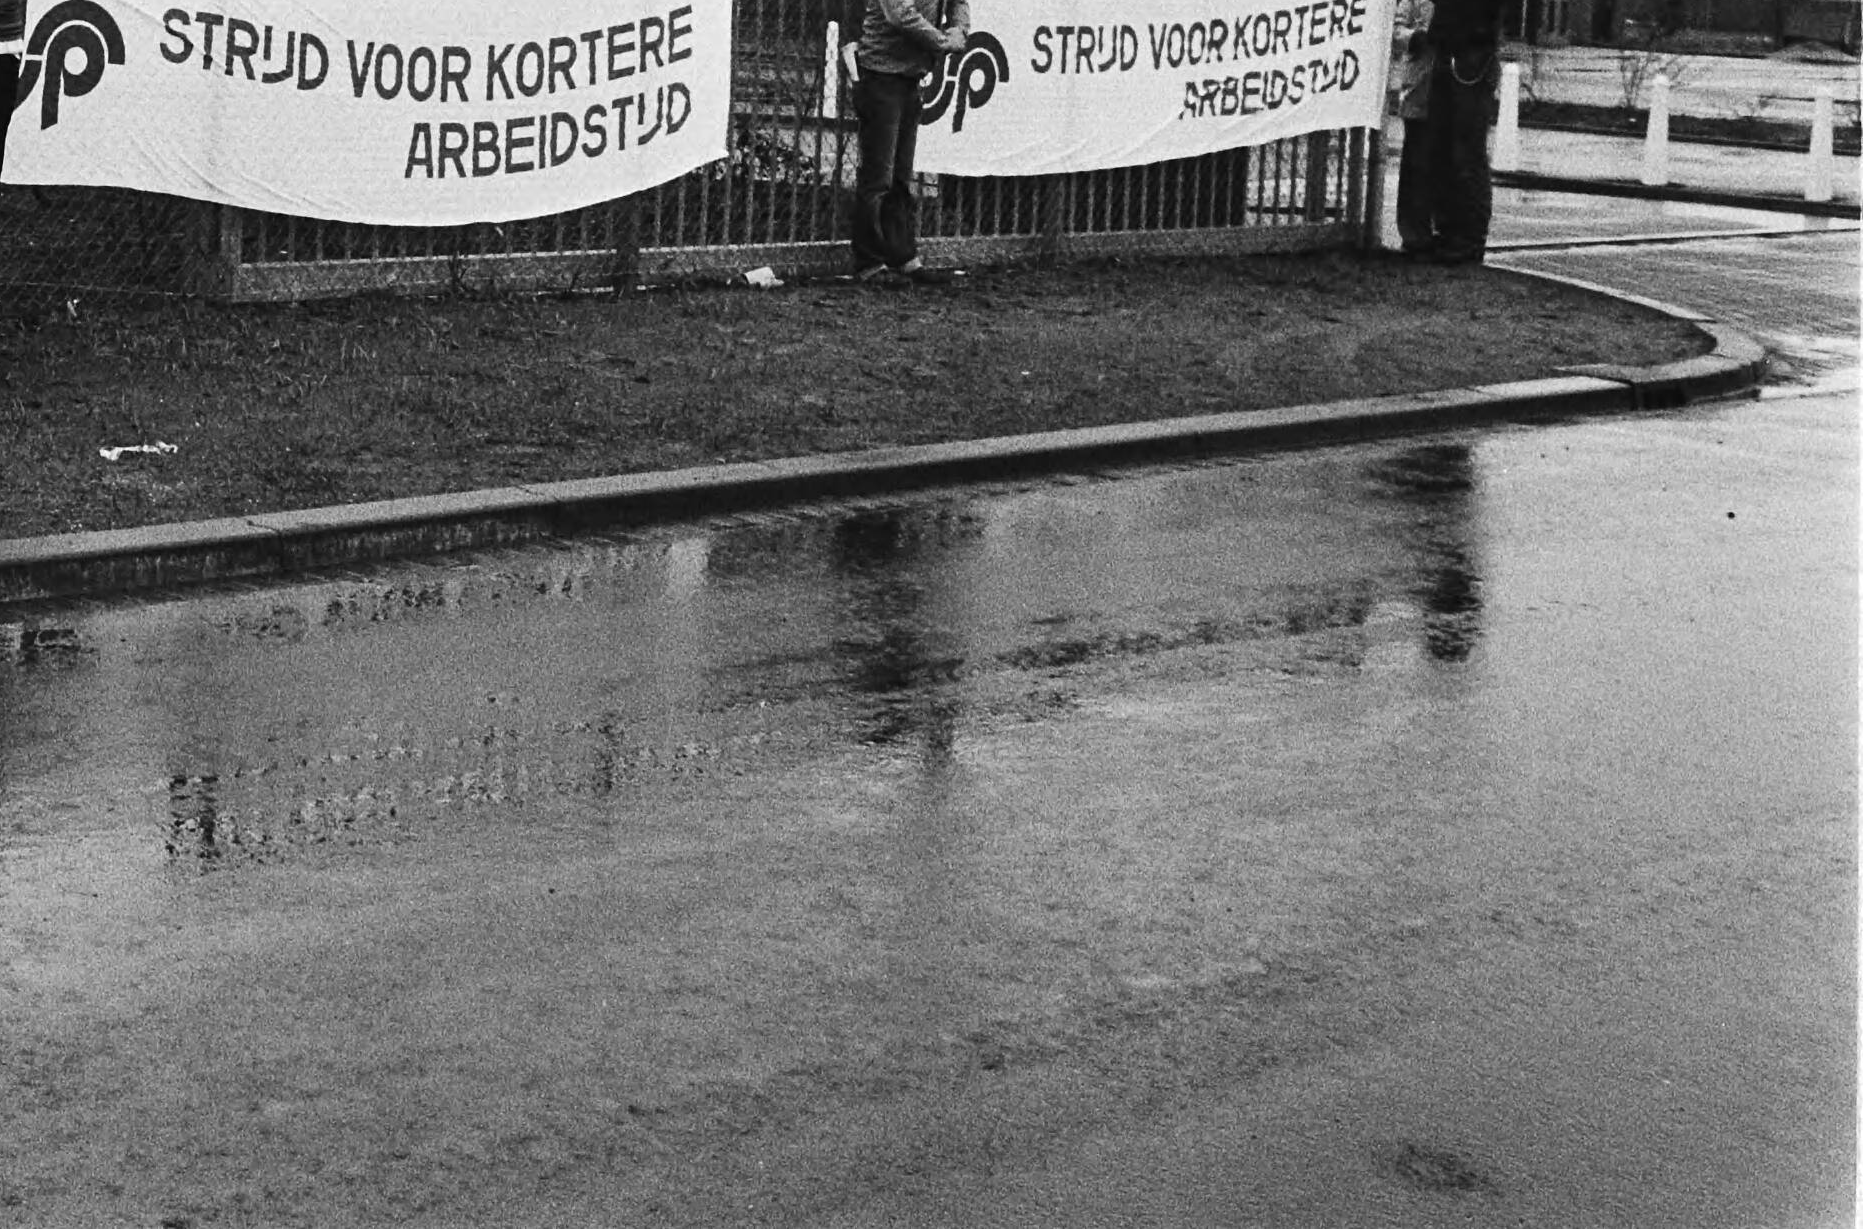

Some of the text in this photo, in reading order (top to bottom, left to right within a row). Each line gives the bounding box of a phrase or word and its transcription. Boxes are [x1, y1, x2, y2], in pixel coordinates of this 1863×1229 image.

[159, 5, 692, 103] STRIJD VOOR KORTERE
[1031, 25, 1139, 74] STRIJD
[1148, 16, 1229, 70] VOOR
[1179, 49, 1360, 120] ARBEIDSTIJD
[404, 82, 691, 179] ARBEIDSTIJD
